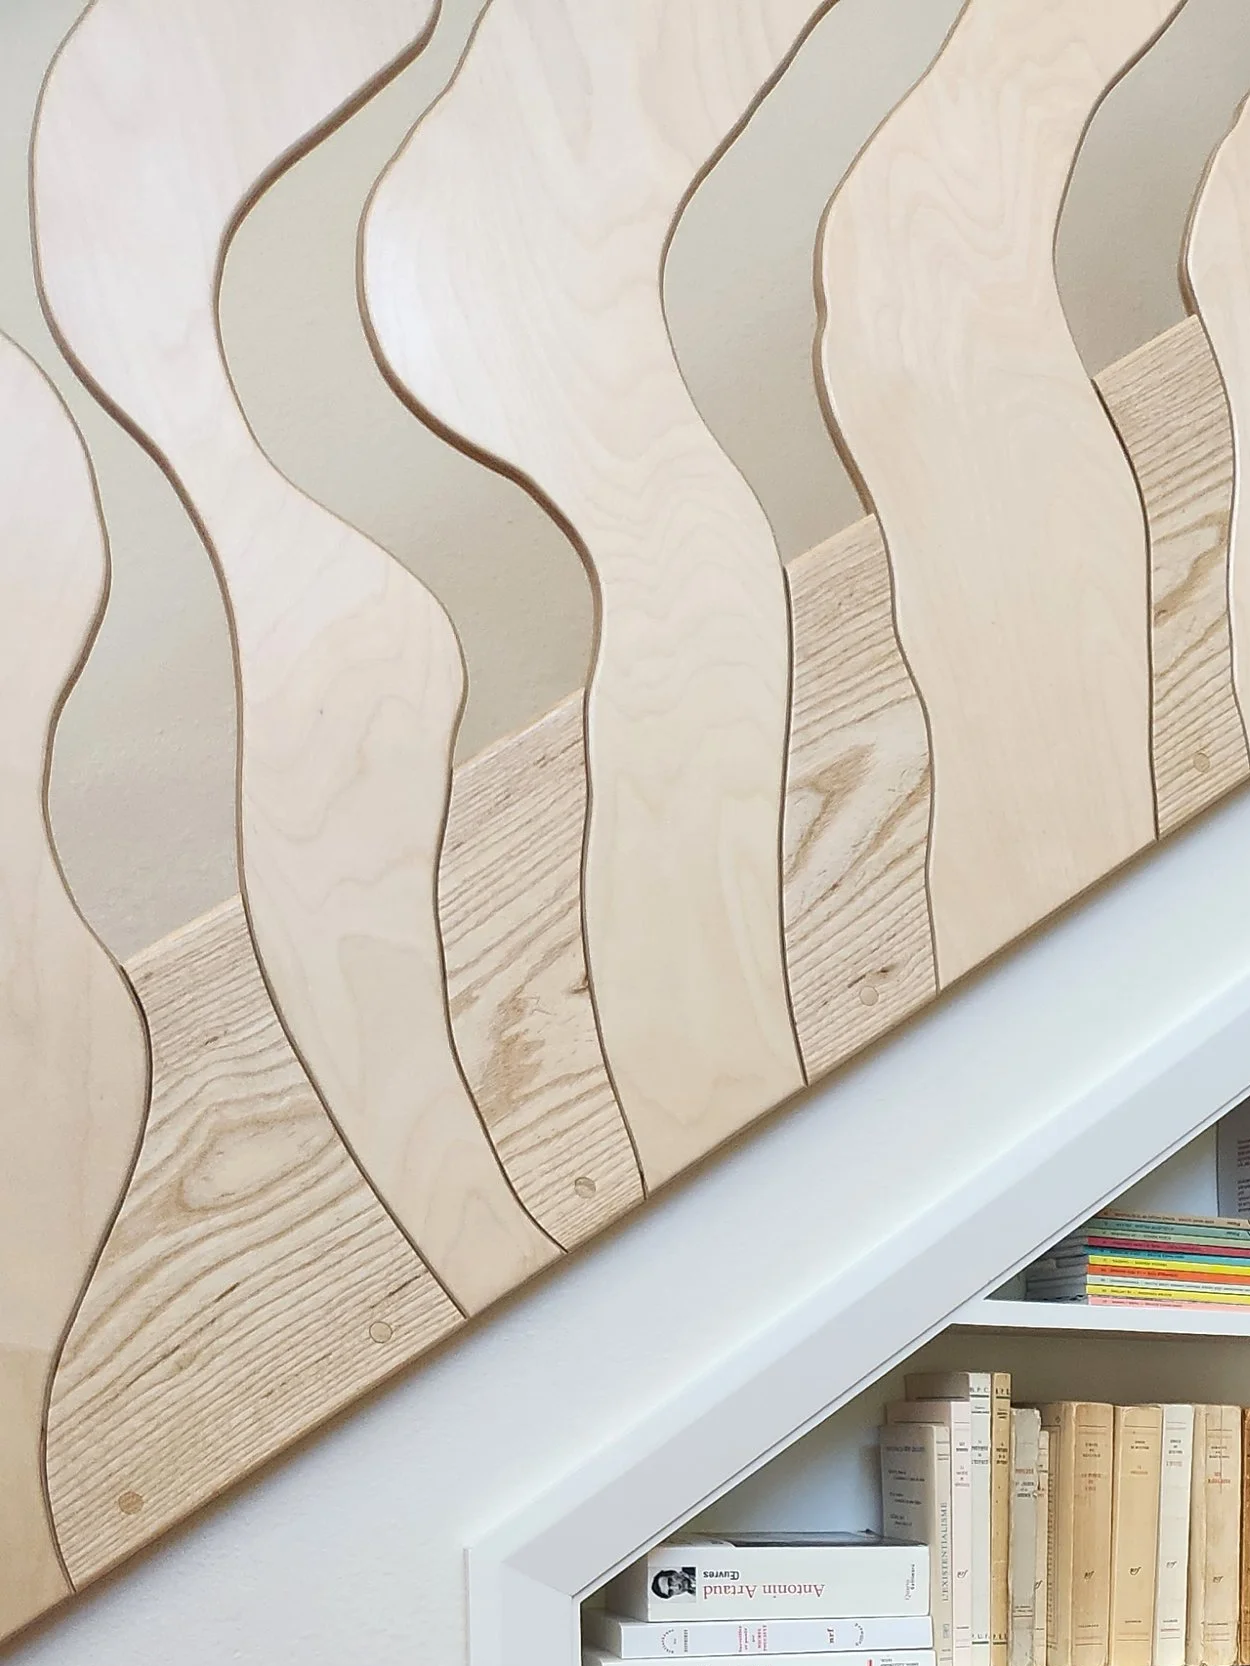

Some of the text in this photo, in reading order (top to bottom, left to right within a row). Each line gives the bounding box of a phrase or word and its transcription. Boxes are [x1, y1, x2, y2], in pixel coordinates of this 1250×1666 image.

[940, 1502, 949, 1602] L'EXISTENTIALISME
[702, 1570, 740, 1581] Œuvres
[702, 1584, 826, 1600] Antonin Artaud
[827, 1628, 835, 1644] nrf
